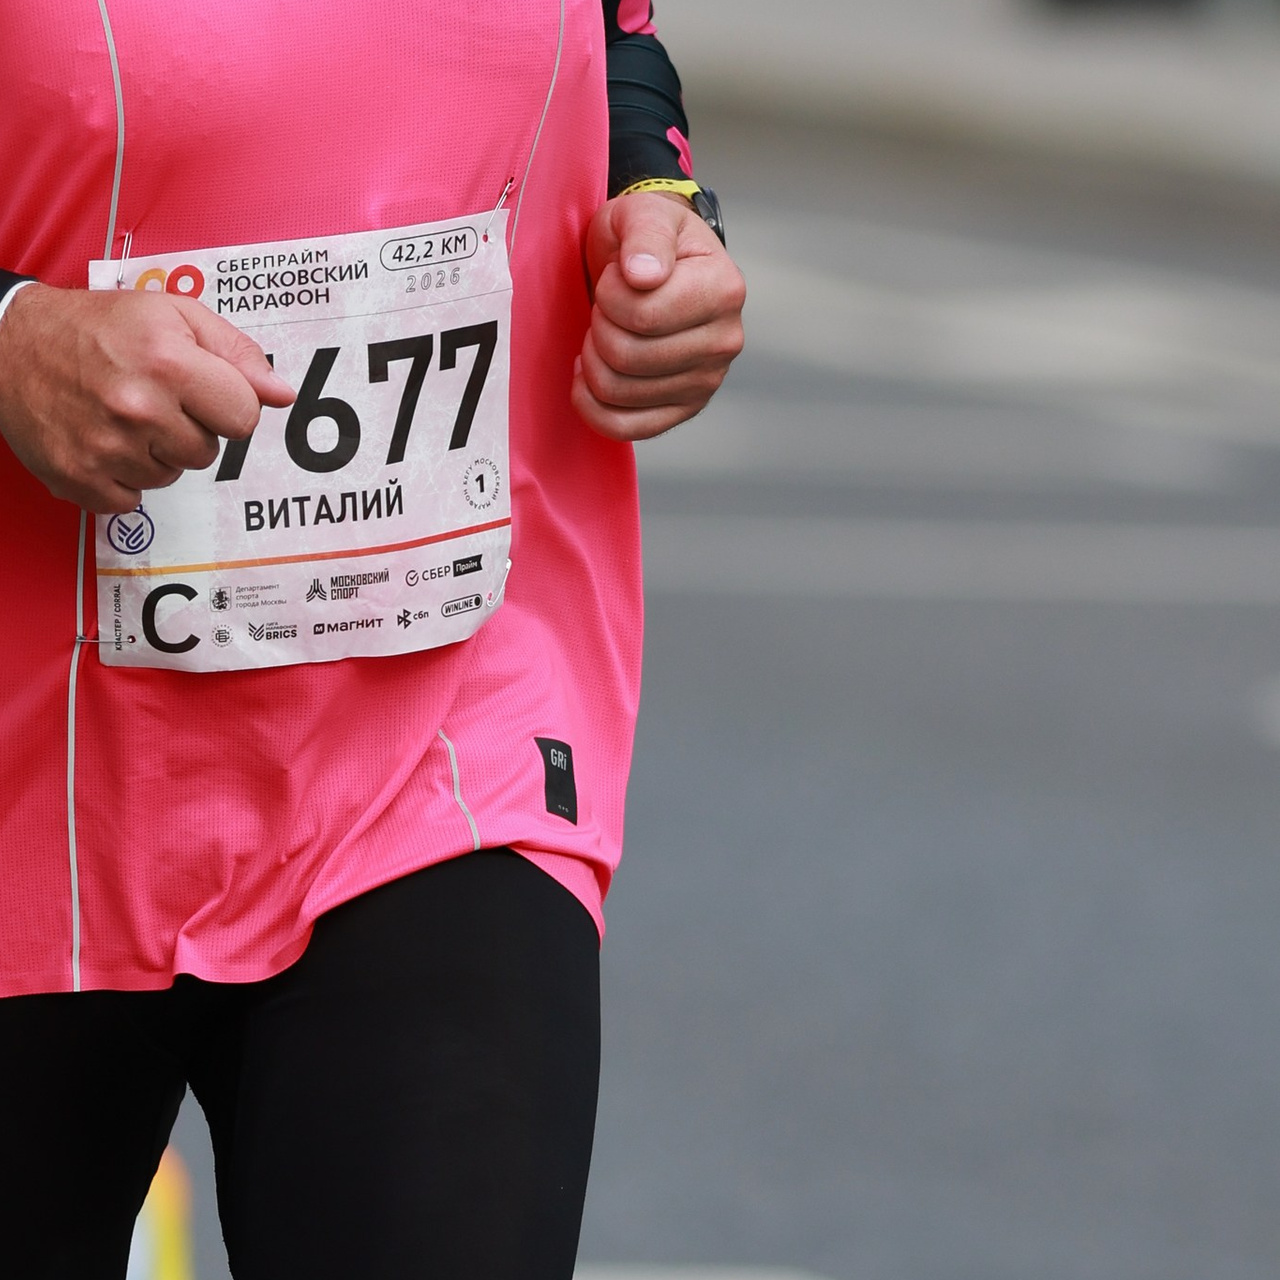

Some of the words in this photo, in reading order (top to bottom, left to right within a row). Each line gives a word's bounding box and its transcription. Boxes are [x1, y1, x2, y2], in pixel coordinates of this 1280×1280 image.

[391, 240, 434, 264] 42,2
[441, 233, 468, 257] КМ
[216, 249, 329, 274] СБЕРПРАЙМ
[217, 259, 369, 294] МОСКОВСКИЙ
[405, 267, 461, 294] 2026
[217, 288, 330, 314] МАРАФОН
[475, 473, 485, 493] 1
[244, 479, 404, 532] ВИТАЛИЙ
[330, 568, 390, 588] МОСКОВСКИЙ
[421, 565, 451, 581] СБЕР
[455, 560, 478, 573] Прайм
[113, 583, 122, 613] CORRAL
[235, 583, 280, 595] Департамент
[235, 593, 259, 601] спорта
[330, 587, 360, 601] СПОРТ
[236, 600, 259, 609] города
[260, 599, 287, 607] Москвы
[445, 598, 473, 614] WINLINE
[114, 618, 123, 651] КЛАСТЕР
[266, 629, 297, 640] BRICS
[550, 748, 567, 771] GRi
